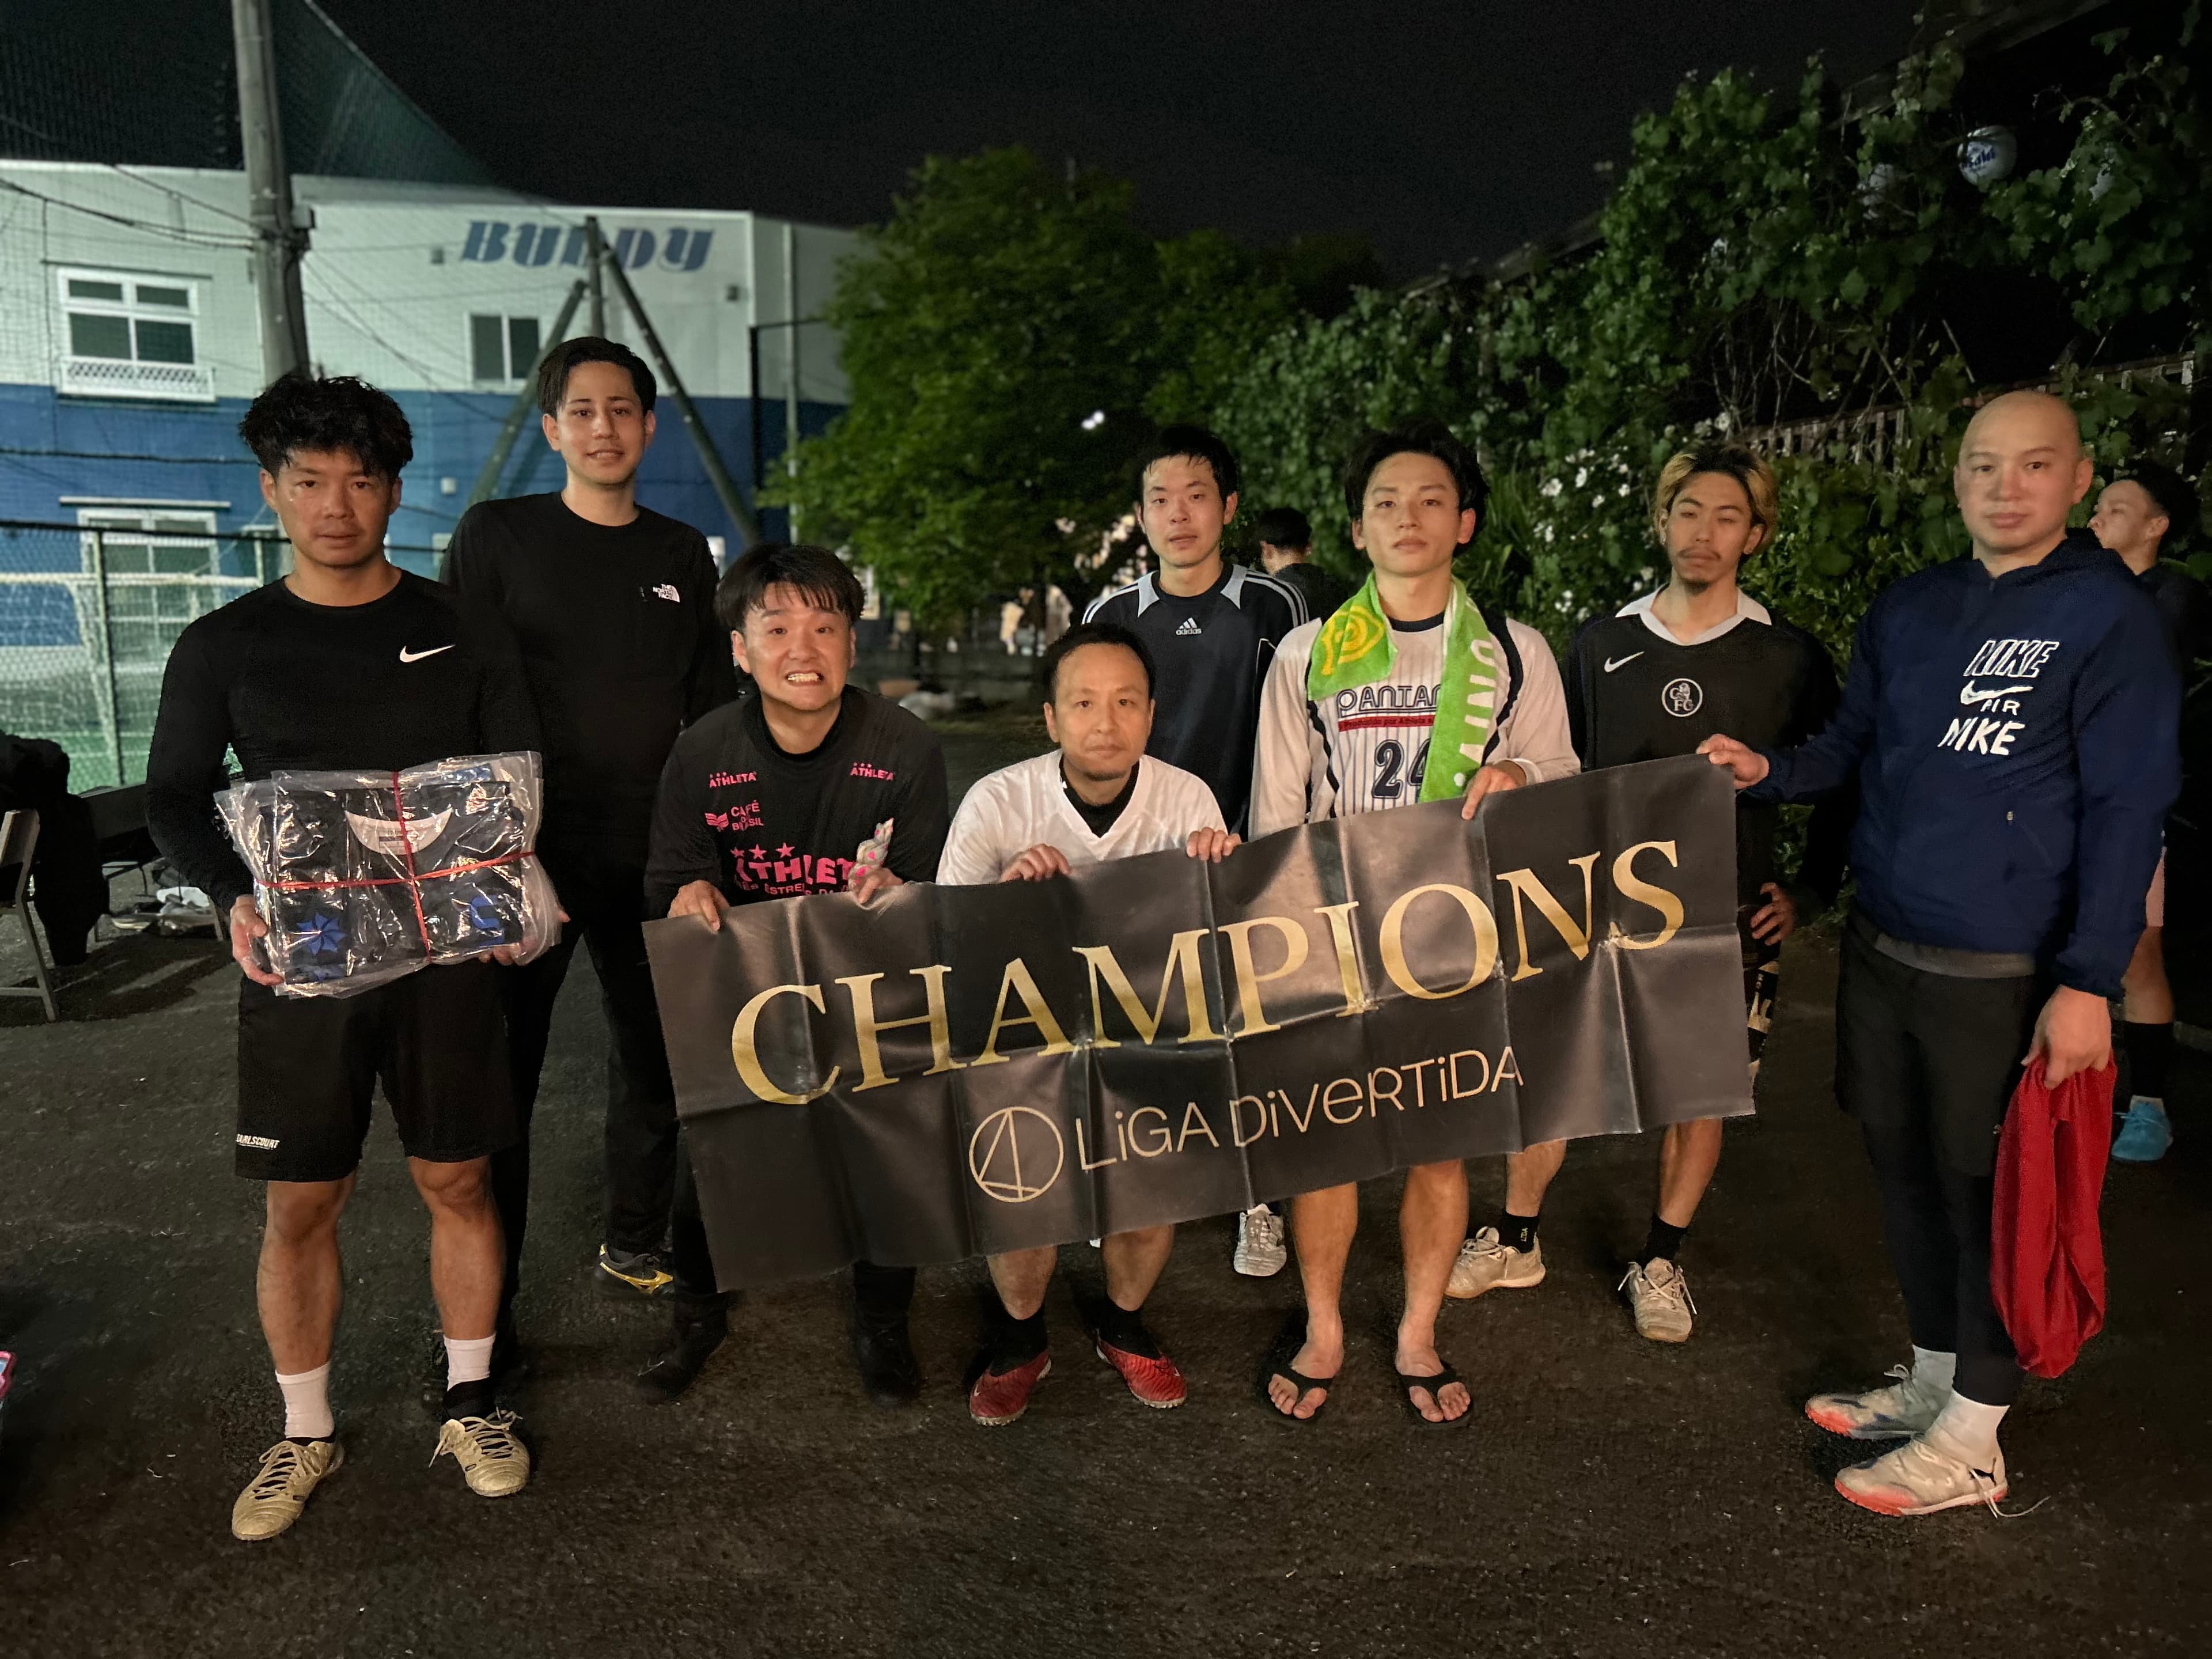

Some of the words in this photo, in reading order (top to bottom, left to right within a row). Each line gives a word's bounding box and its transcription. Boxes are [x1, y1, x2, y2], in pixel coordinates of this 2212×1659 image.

[1980, 699, 2021, 715] AIR
[1937, 717, 2026, 755] NIKE
[709, 772, 756, 788] ATHLETA
[736, 855, 856, 885] THLET
[732, 840, 1684, 1105] CHAMPIONS
